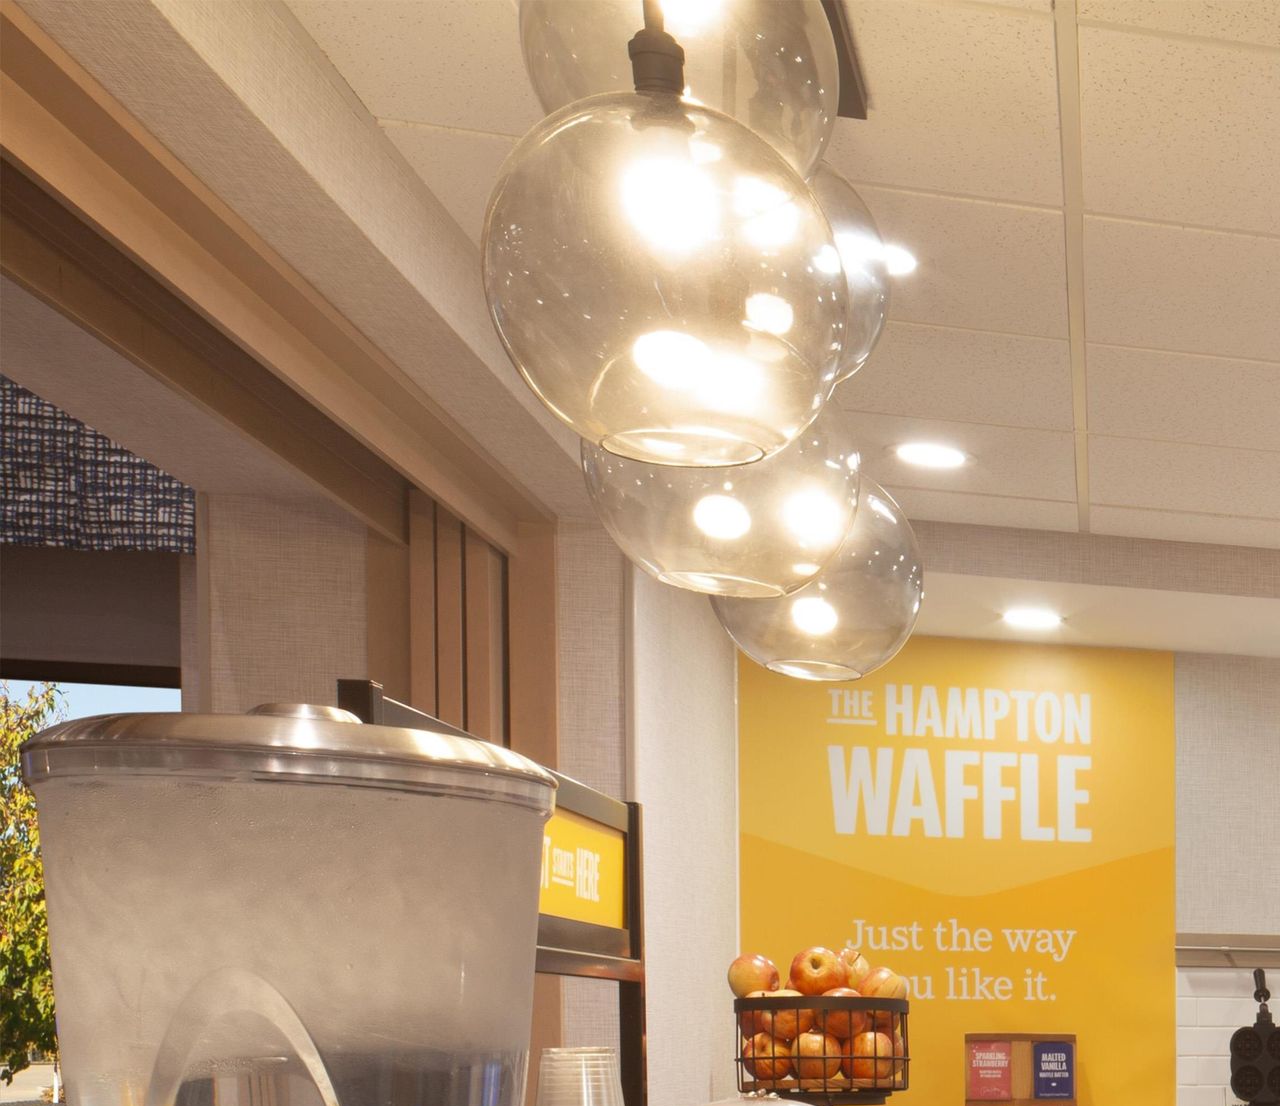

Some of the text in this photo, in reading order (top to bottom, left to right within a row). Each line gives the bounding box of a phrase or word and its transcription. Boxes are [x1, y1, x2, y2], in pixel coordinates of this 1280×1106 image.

[828, 684, 1091, 744] THE HAMPTON
[827, 745, 1092, 843] WAFFLE
[576, 847, 600, 902] HERE
[846, 918, 1077, 962] Just the way
[945, 967, 1013, 1000] like
[1024, 968, 1057, 1000] it.
[1041, 1053, 1066, 1061] MALTED
[1041, 1062, 1067, 1071] VANILLA
